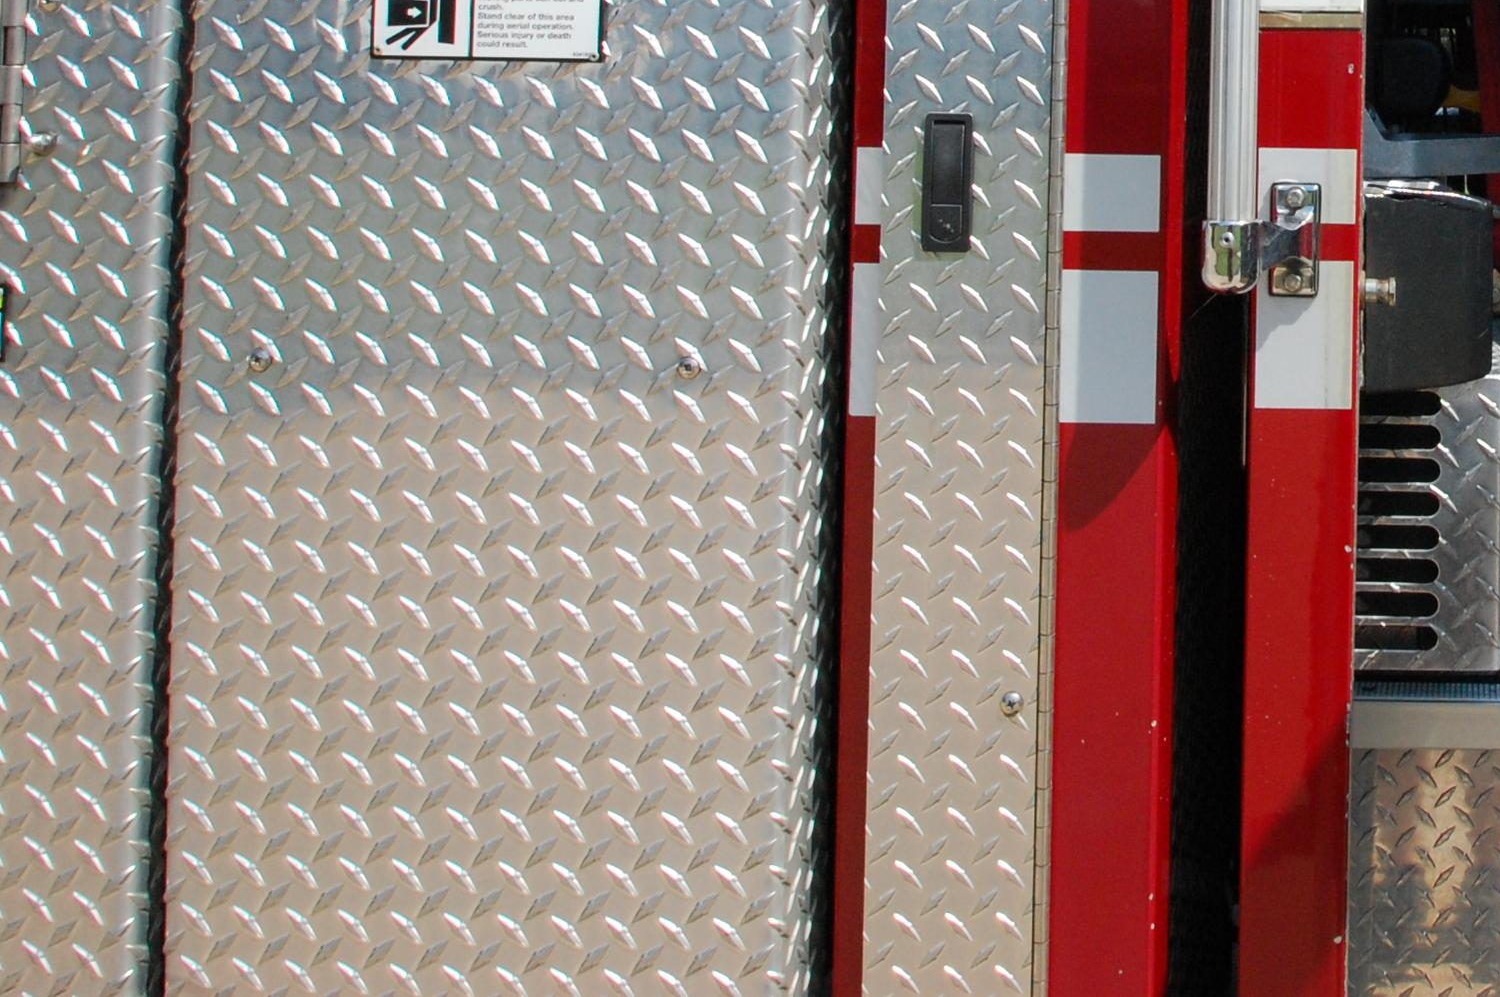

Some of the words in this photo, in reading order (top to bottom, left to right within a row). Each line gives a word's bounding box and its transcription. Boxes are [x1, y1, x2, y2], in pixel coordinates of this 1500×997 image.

[478, 3, 504, 11] crush.
[477, 12, 503, 20] Stand
[538, 13, 554, 21] this
[477, 22, 504, 30] during
[506, 22, 530, 30] aerial
[531, 23, 574, 31] operation.
[477, 31, 509, 39] Serious
[511, 32, 534, 40] injury
[547, 32, 572, 40] death
[476, 40, 500, 48] could
